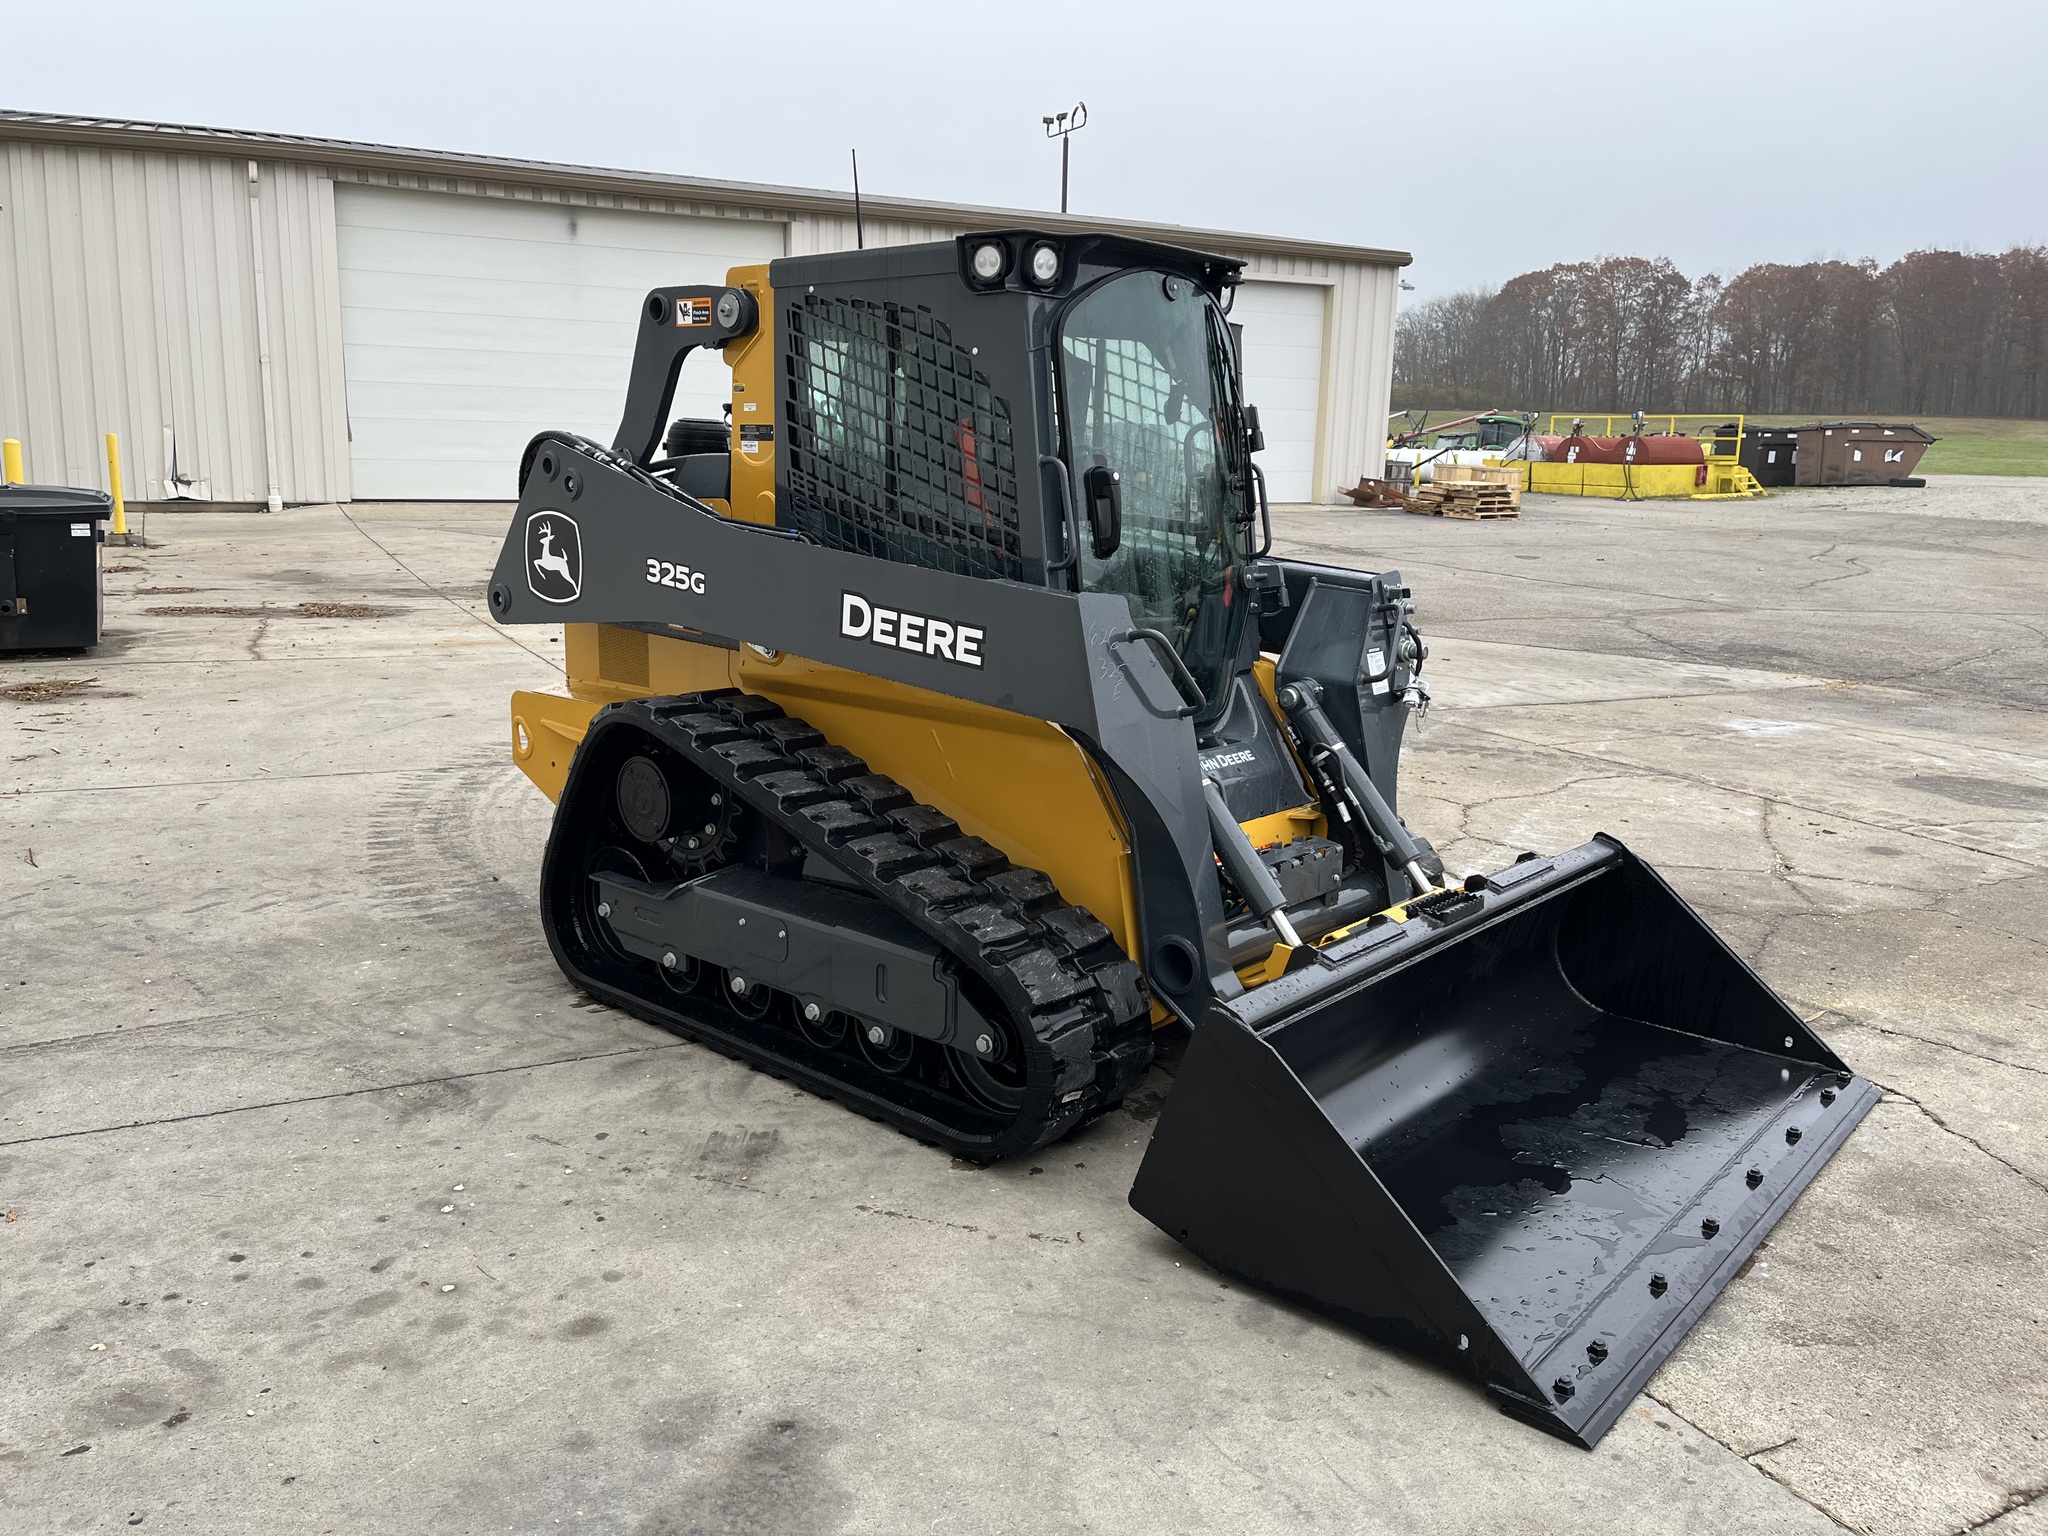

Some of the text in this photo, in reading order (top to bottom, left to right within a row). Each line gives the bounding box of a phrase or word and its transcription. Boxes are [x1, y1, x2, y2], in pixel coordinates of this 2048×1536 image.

[646, 558, 705, 594] 325G
[842, 593, 983, 666] DEERE
[1099, 658, 1125, 682] 325
[1200, 750, 1255, 771] HN DEERE
